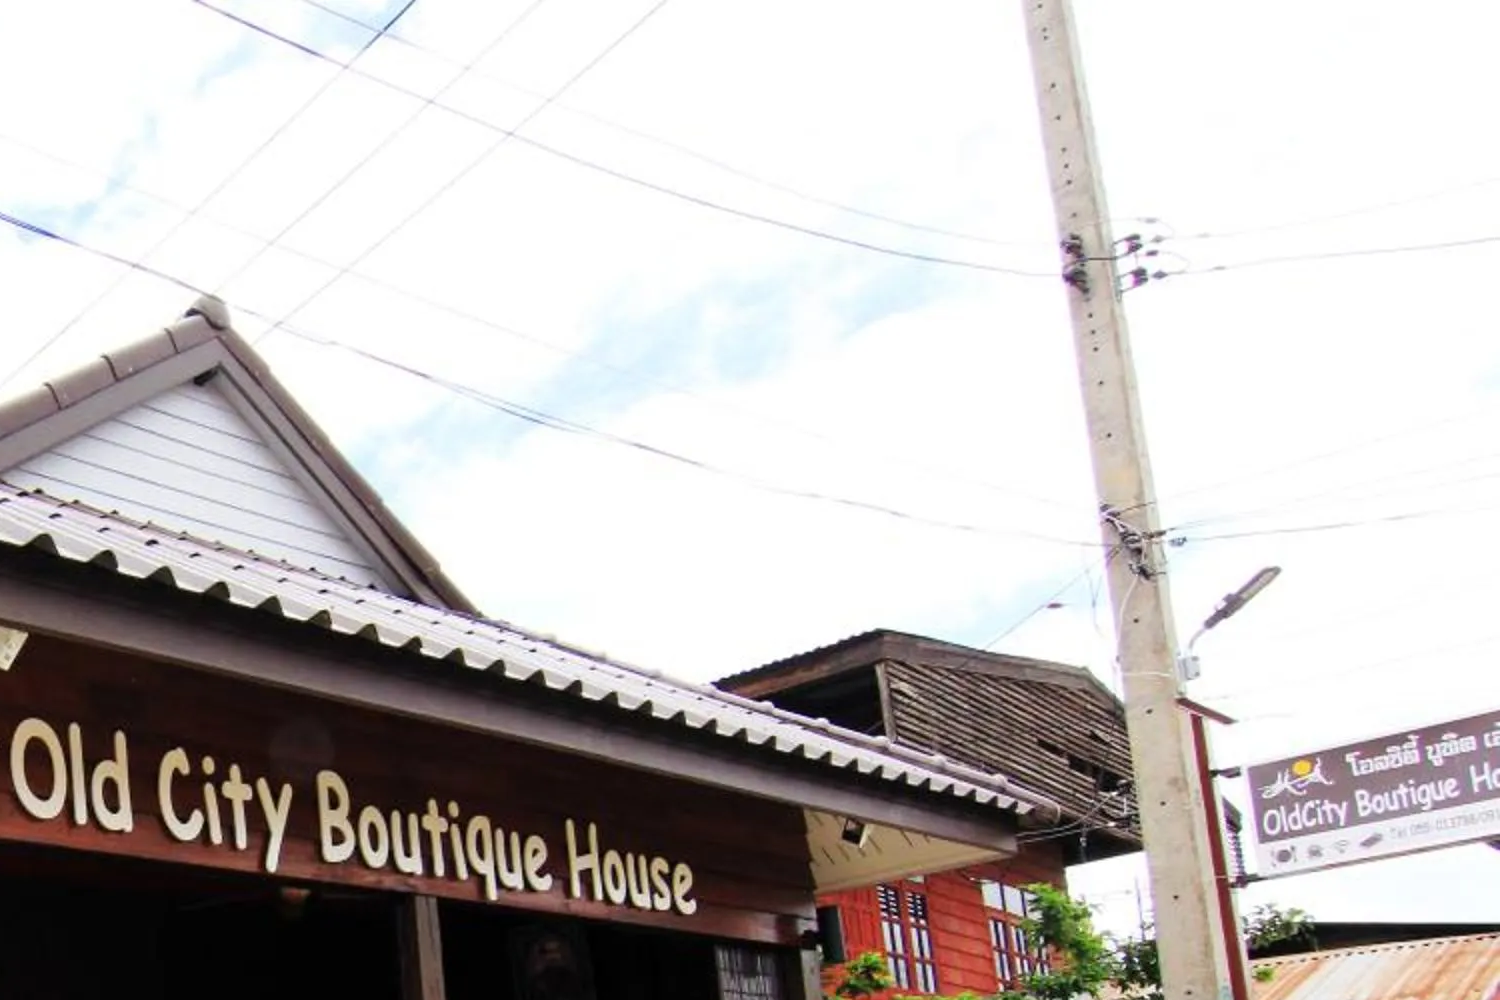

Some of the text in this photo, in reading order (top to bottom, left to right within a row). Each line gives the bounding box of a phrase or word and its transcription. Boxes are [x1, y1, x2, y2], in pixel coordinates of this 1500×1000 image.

[10, 718, 697, 915] Old City Boutique House
[1355, 777, 1460, 817] Boutique
